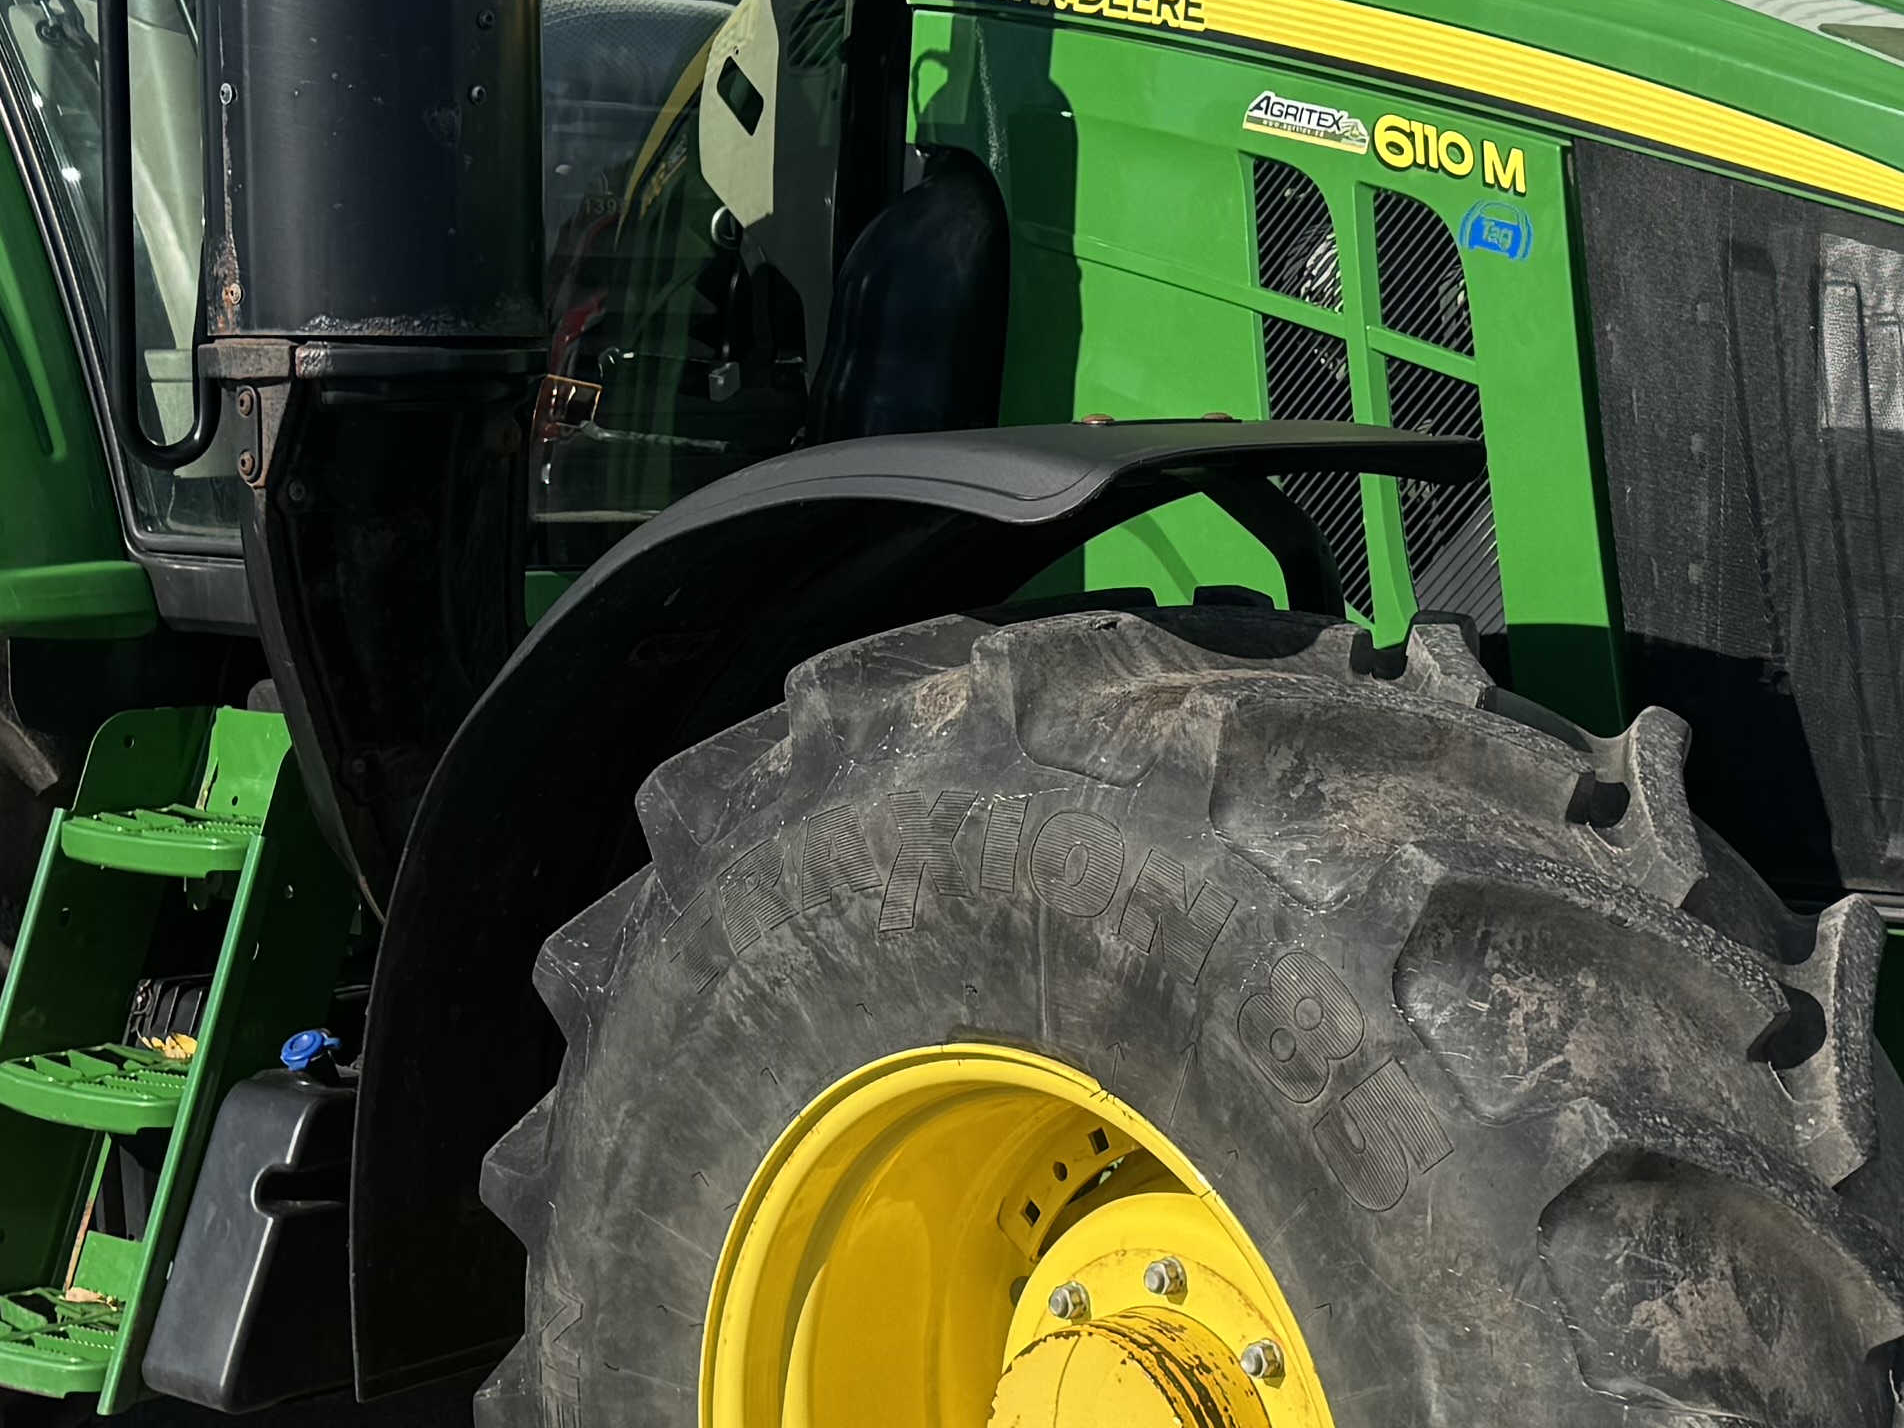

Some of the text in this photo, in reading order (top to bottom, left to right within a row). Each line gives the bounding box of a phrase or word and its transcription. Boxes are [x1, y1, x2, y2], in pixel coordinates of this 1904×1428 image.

[1249, 95, 1344, 132] AGRITEX
[1372, 113, 1527, 197] 6110 M
[663, 789, 1454, 1212] TRAXION 85
